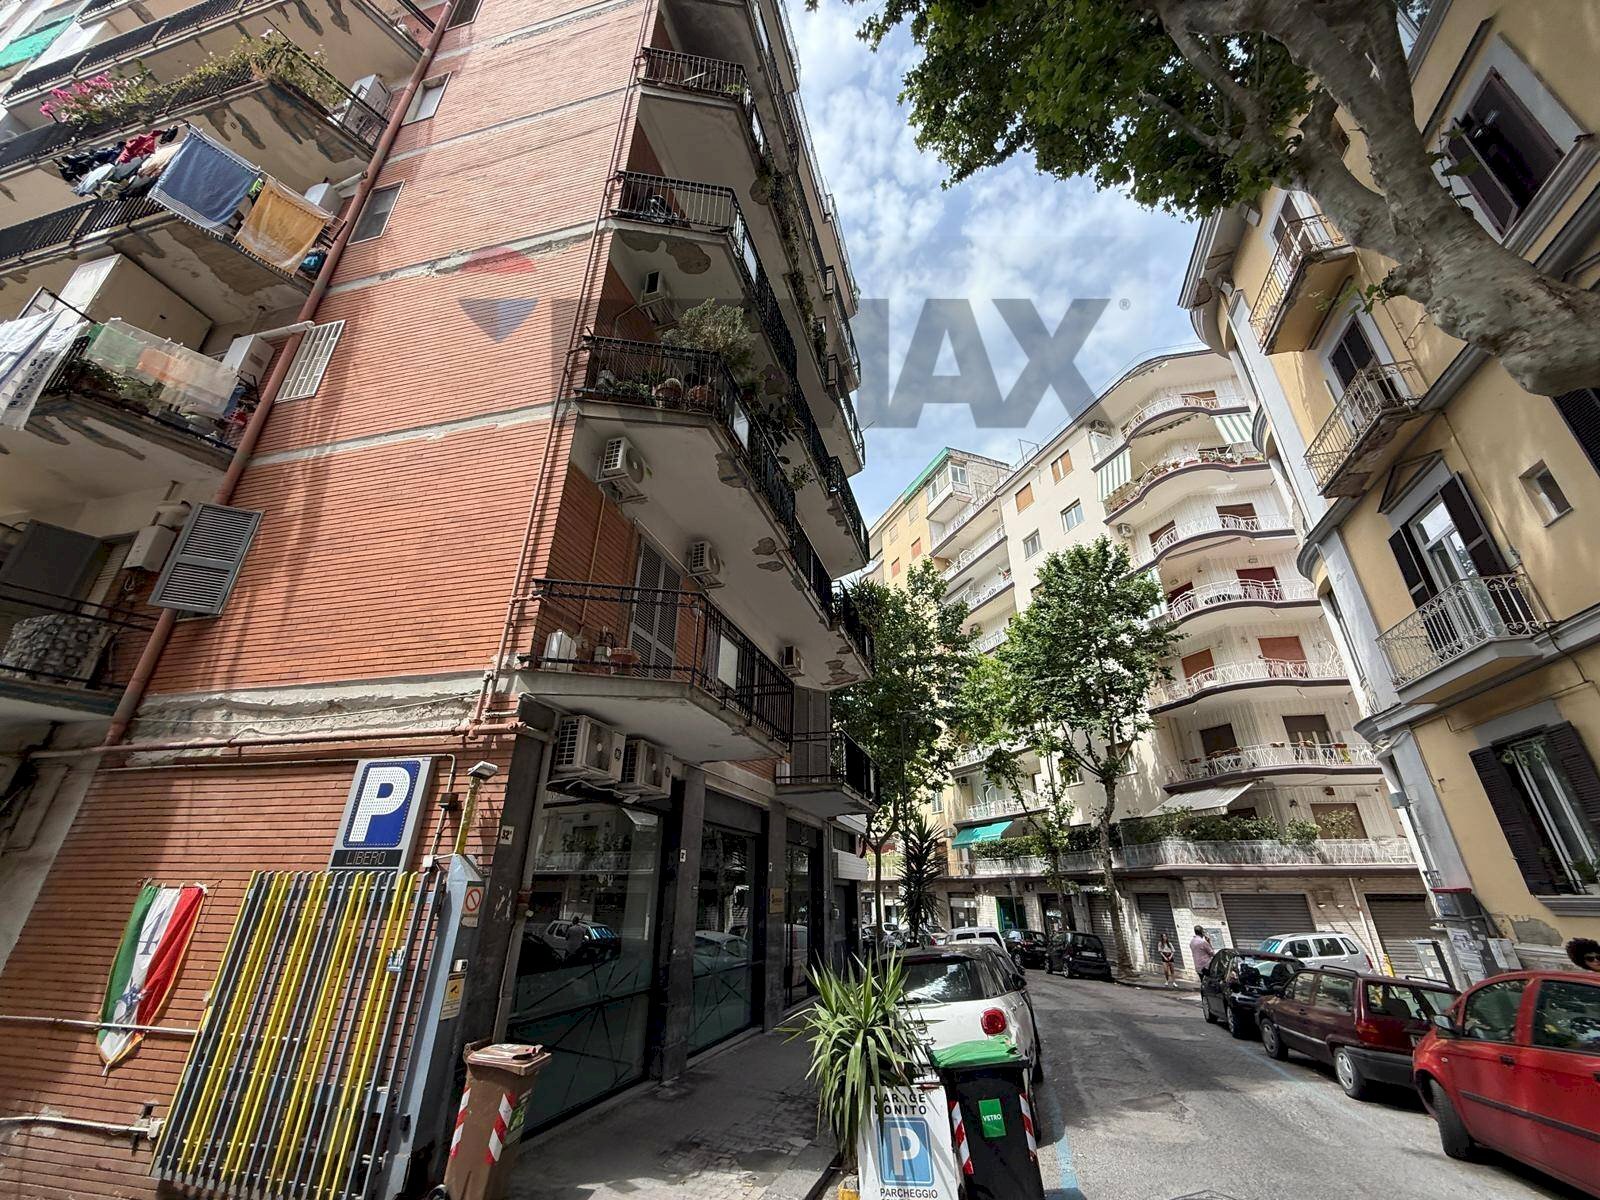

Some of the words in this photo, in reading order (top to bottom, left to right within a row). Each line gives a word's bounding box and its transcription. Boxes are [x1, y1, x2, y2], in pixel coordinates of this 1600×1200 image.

[348, 766, 411, 842] P
[345, 851, 387, 865] LIBERO
[983, 1113, 1002, 1122] VETRO
[891, 1128, 920, 1176] P
[880, 1187, 938, 1199] PARCHEGGIO
